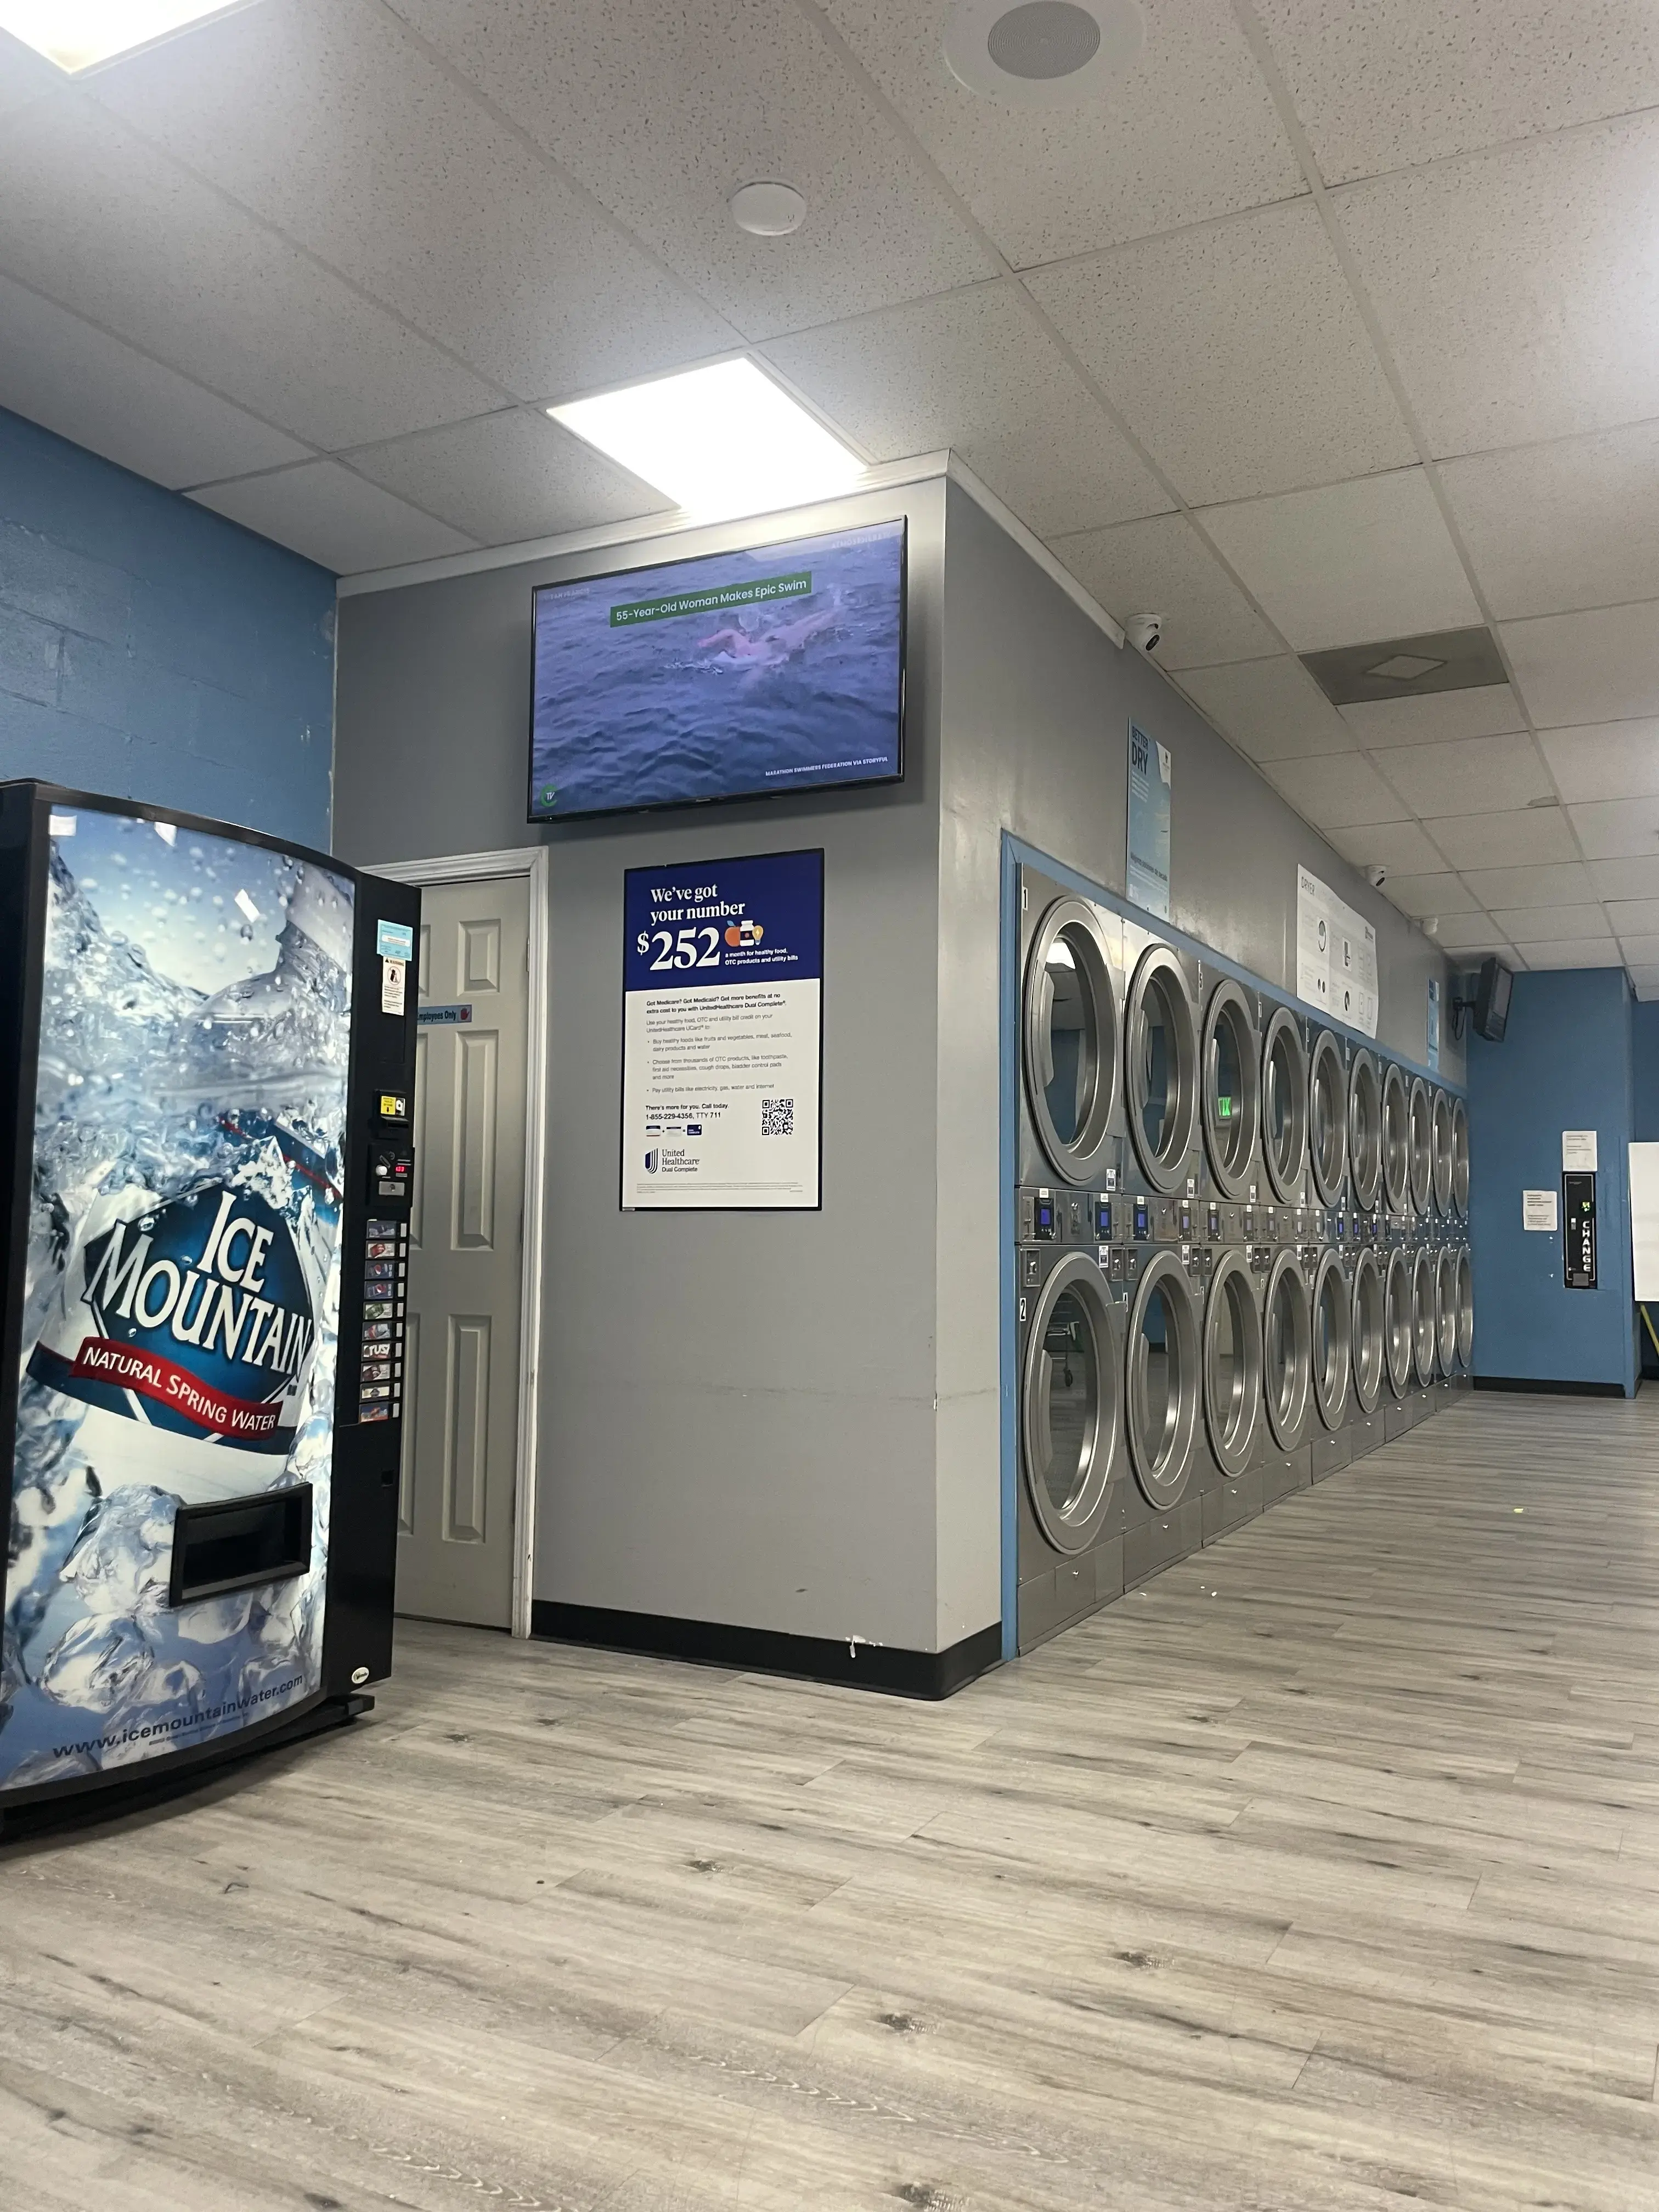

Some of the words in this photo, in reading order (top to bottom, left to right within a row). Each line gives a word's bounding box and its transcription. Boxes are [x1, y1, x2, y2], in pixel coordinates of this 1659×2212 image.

[617, 602, 676, 620] 55-Year-Old
[679, 596, 718, 610] Woman
[720, 589, 753, 602] Makes
[755, 584, 776, 599] Epic
[778, 579, 806, 593] Swim
[822, 761, 852, 769] FEDERATION
[1132, 741, 1148, 775] DRY
[651, 887, 692, 902] We've
[695, 884, 718, 902] got
[651, 909, 684, 926] your
[686, 901, 745, 919] number
[637, 927, 720, 970] $252
[444, 1011, 456, 1020] Only
[662, 1149, 685, 1157] United
[662, 1157, 700, 1166] Healthcare
[197, 1190, 274, 1293] ICE
[1582, 1221, 1591, 1272] CHANGE
[81, 1224, 312, 1379] MOUNTAIN
[1020, 1299, 1025, 1320] 2
[83, 1347, 162, 1388] NATURAL
[166, 1374, 227, 1423] SPRING
[232, 1408, 276, 1430] WATER
